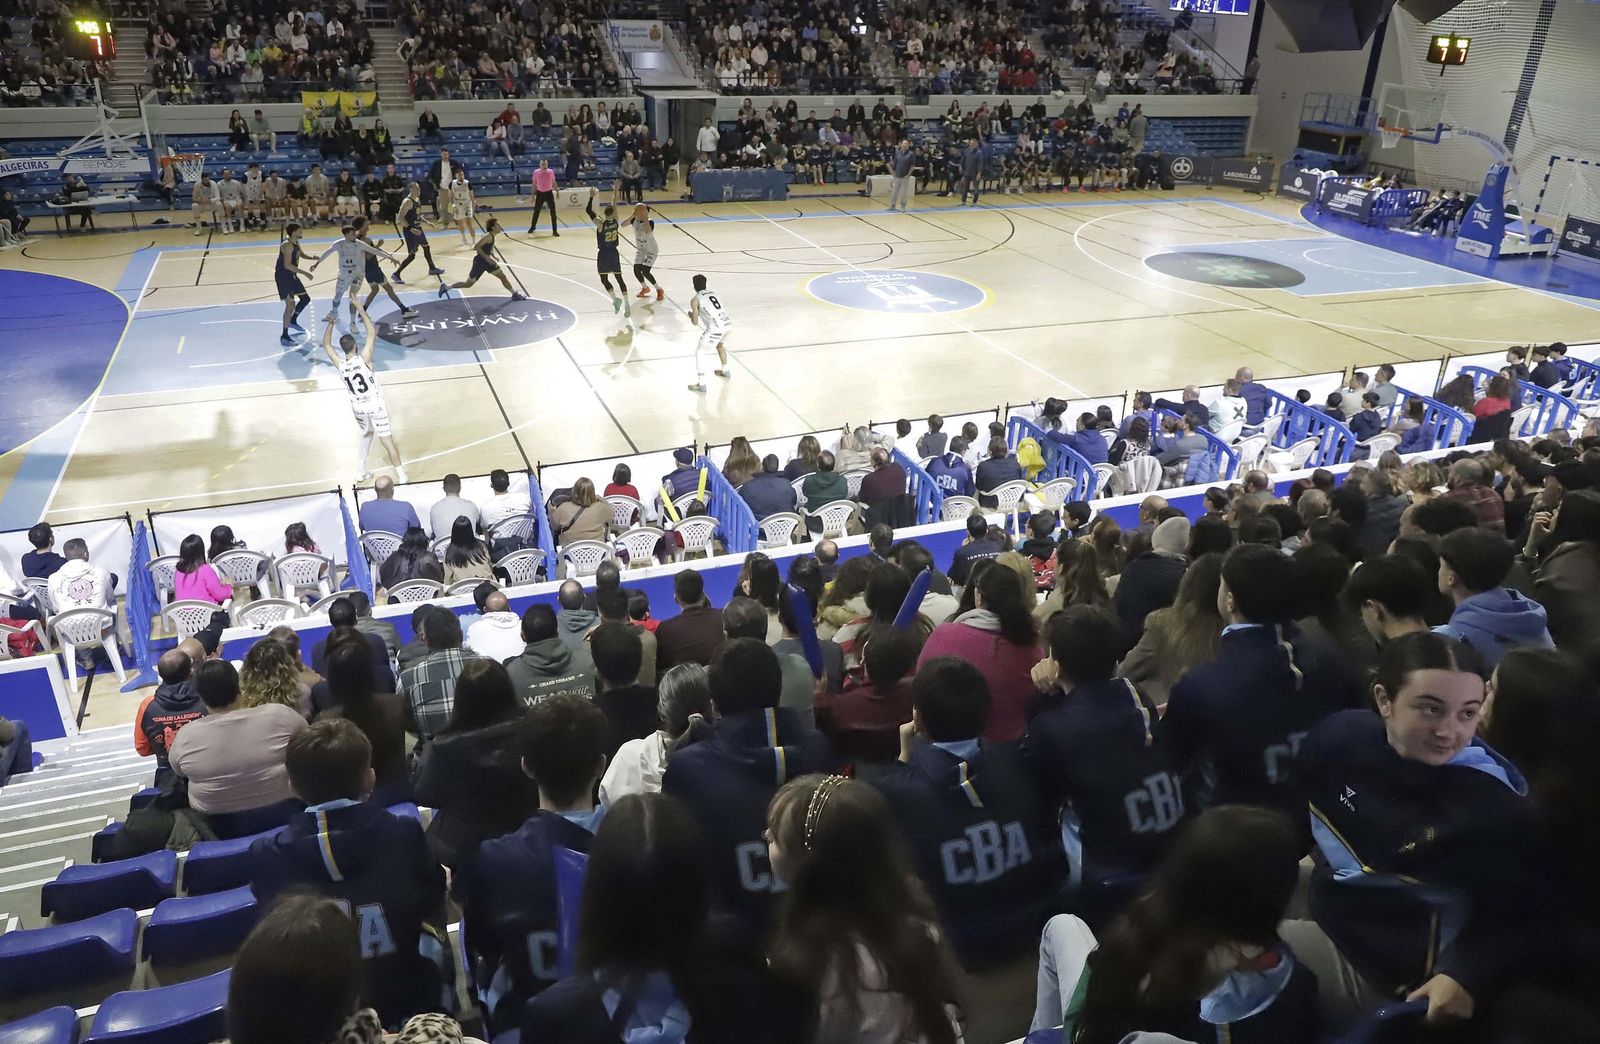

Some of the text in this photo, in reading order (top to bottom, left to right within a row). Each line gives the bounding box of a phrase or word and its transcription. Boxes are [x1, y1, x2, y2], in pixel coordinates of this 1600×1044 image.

[90, 35, 103, 56] 7
[0, 160, 49, 173] ALGECIRAS
[1473, 210, 1492, 223] TME
[708, 295, 722, 310] 8
[392, 311, 561, 334] HAWKINS
[344, 373, 369, 395] 13
[936, 474, 958, 490] CBA
[941, 819, 1033, 885] CBA
